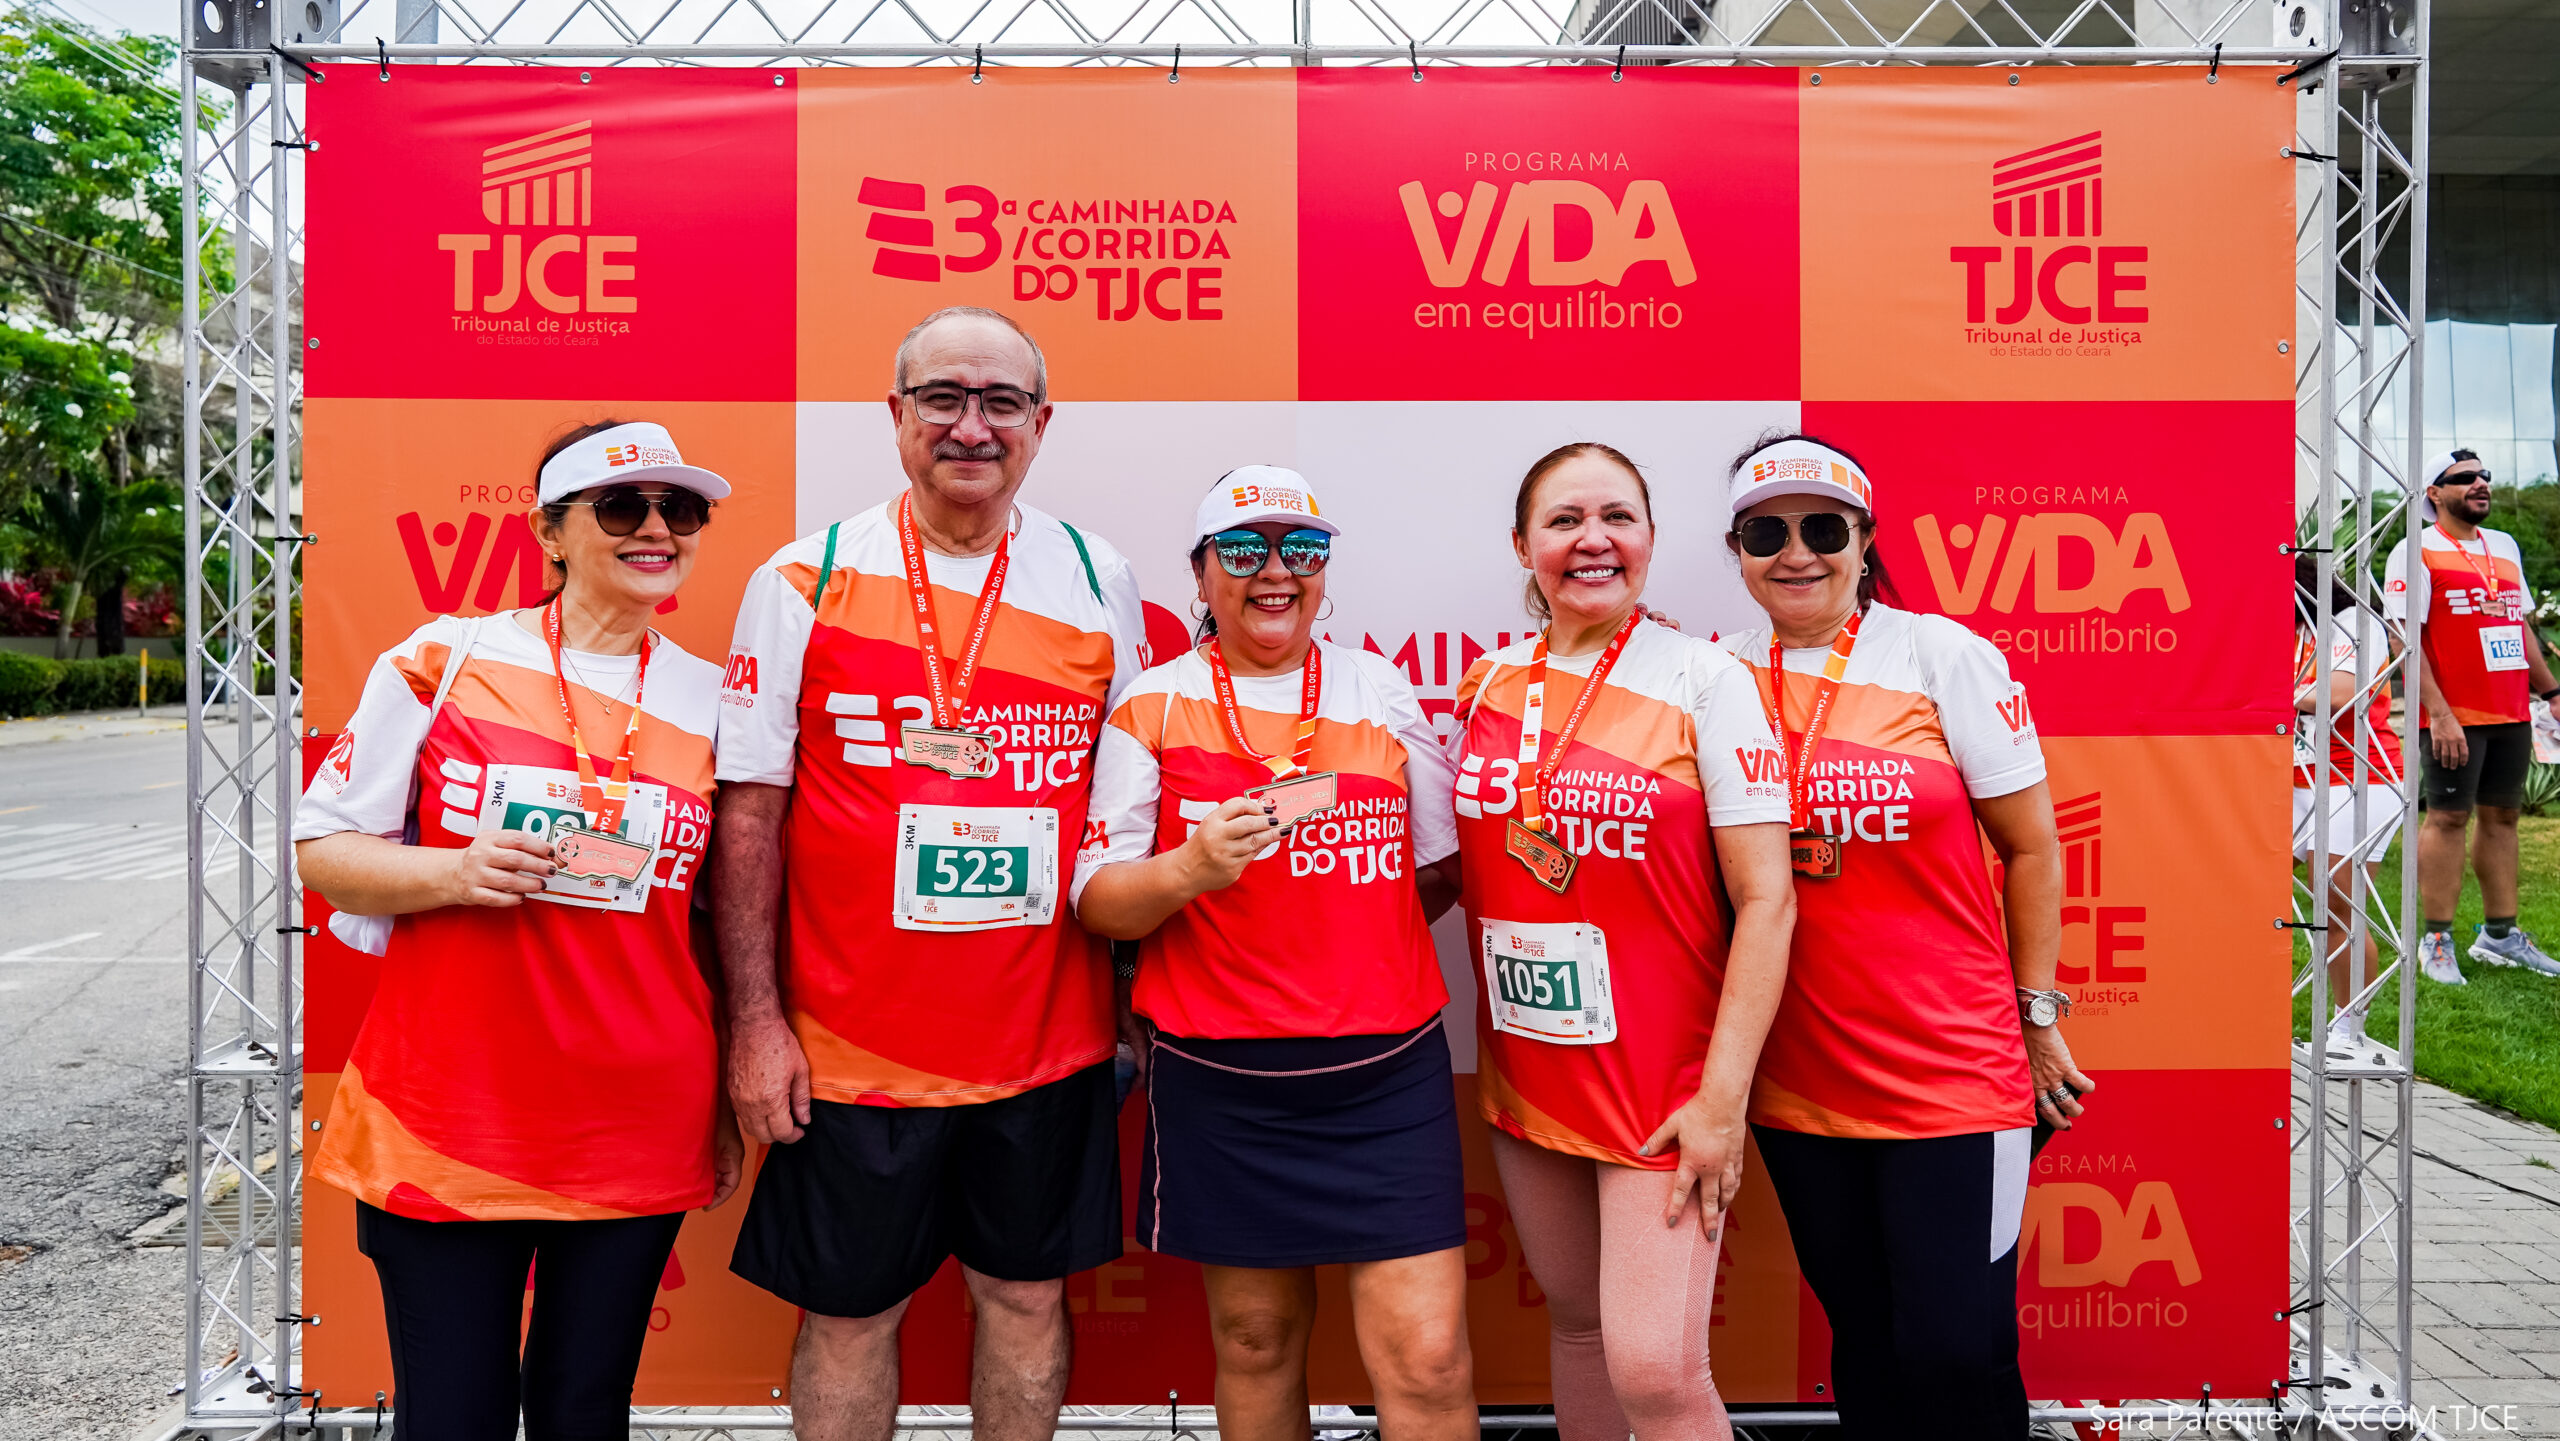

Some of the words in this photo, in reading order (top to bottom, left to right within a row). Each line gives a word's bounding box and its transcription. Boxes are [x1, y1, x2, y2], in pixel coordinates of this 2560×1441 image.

[1465, 152, 1629, 171] PROGRAMA
[1027, 200, 1237, 224] CAMINHADA
[1013, 226, 1231, 261] /CORRIDA
[1398, 180, 1698, 287] VIDA
[438, 234, 638, 314] TJCE
[1950, 245, 2149, 325] TJCE
[1013, 264, 1078, 301] DO
[1086, 266, 1223, 322] TJCE
[452, 316, 530, 332] Tribunal
[536, 317, 560, 333] de
[566, 318, 630, 337] Justiça
[1414, 302, 1471, 328] em
[1482, 290, 1683, 340] equilíbrio
[476, 335, 494, 346] do
[497, 334, 540, 346] Estado
[543, 335, 560, 346] do
[563, 334, 599, 346] Ceará
[1964, 328, 2042, 344] Tribunal
[2049, 329, 2072, 344] de
[2078, 328, 2142, 347] Justiça
[1989, 346, 2007, 357] do
[2010, 346, 2052, 357] Estado
[2055, 346, 2072, 357] do
[2076, 345, 2111, 357] Ceará
[1779, 470, 1792, 479] DO
[1794, 470, 1821, 480] TJCE
[460, 485, 533, 503] PROG
[1263, 498, 1277, 506] DO
[1278, 499, 1303, 512] TJCE
[1975, 487, 2129, 504] PROGRAMA
[909, 556, 919, 569] DO
[1913, 513, 2192, 615] VIDA
[912, 569, 923, 589] TJCE
[915, 593, 927, 613] 2026
[962, 590, 998, 678] CAMINHADA/CORRIDA
[991, 575, 1002, 589] DO
[1991, 617, 2178, 664] equilíbrio
[2492, 640, 2521, 658] 1865
[1308, 673, 1317, 684] DO
[928, 654, 950, 728] CAMINHADA/CO
[1223, 697, 1234, 708] DO
[960, 703, 1097, 724] CAMINHADA
[1556, 665, 1605, 748] CAMINHADA/CORRIDA
[963, 724, 1092, 748] ORRIDA
[1796, 698, 1828, 787] CAMINHADA/CORRIDA
[940, 751, 958, 760] TJCE
[1549, 746, 1561, 761] DO
[491, 780, 506, 807] 3KM
[1482, 757, 1519, 815] 3
[1536, 769, 1661, 795] MINHADA
[1746, 787, 1763, 797] em
[1548, 788, 1655, 820] ORRIDA
[1288, 816, 1405, 849] /CORRIDA
[1813, 804, 1910, 844] TJCE
[905, 825, 916, 850] 3KM
[981, 834, 999, 843] TJCE
[1561, 815, 1648, 861] TJCE
[933, 849, 1014, 893] 523
[1289, 848, 1336, 877] DO
[1340, 841, 1402, 885] TJCE
[1499, 959, 1575, 1007] 1051
[2076, 987, 2139, 1006] Justiça
[2074, 1004, 2109, 1017] Ceará
[2036, 1154, 2138, 1174] GRAMA
[2018, 1291, 2188, 1340] quilíbrio
